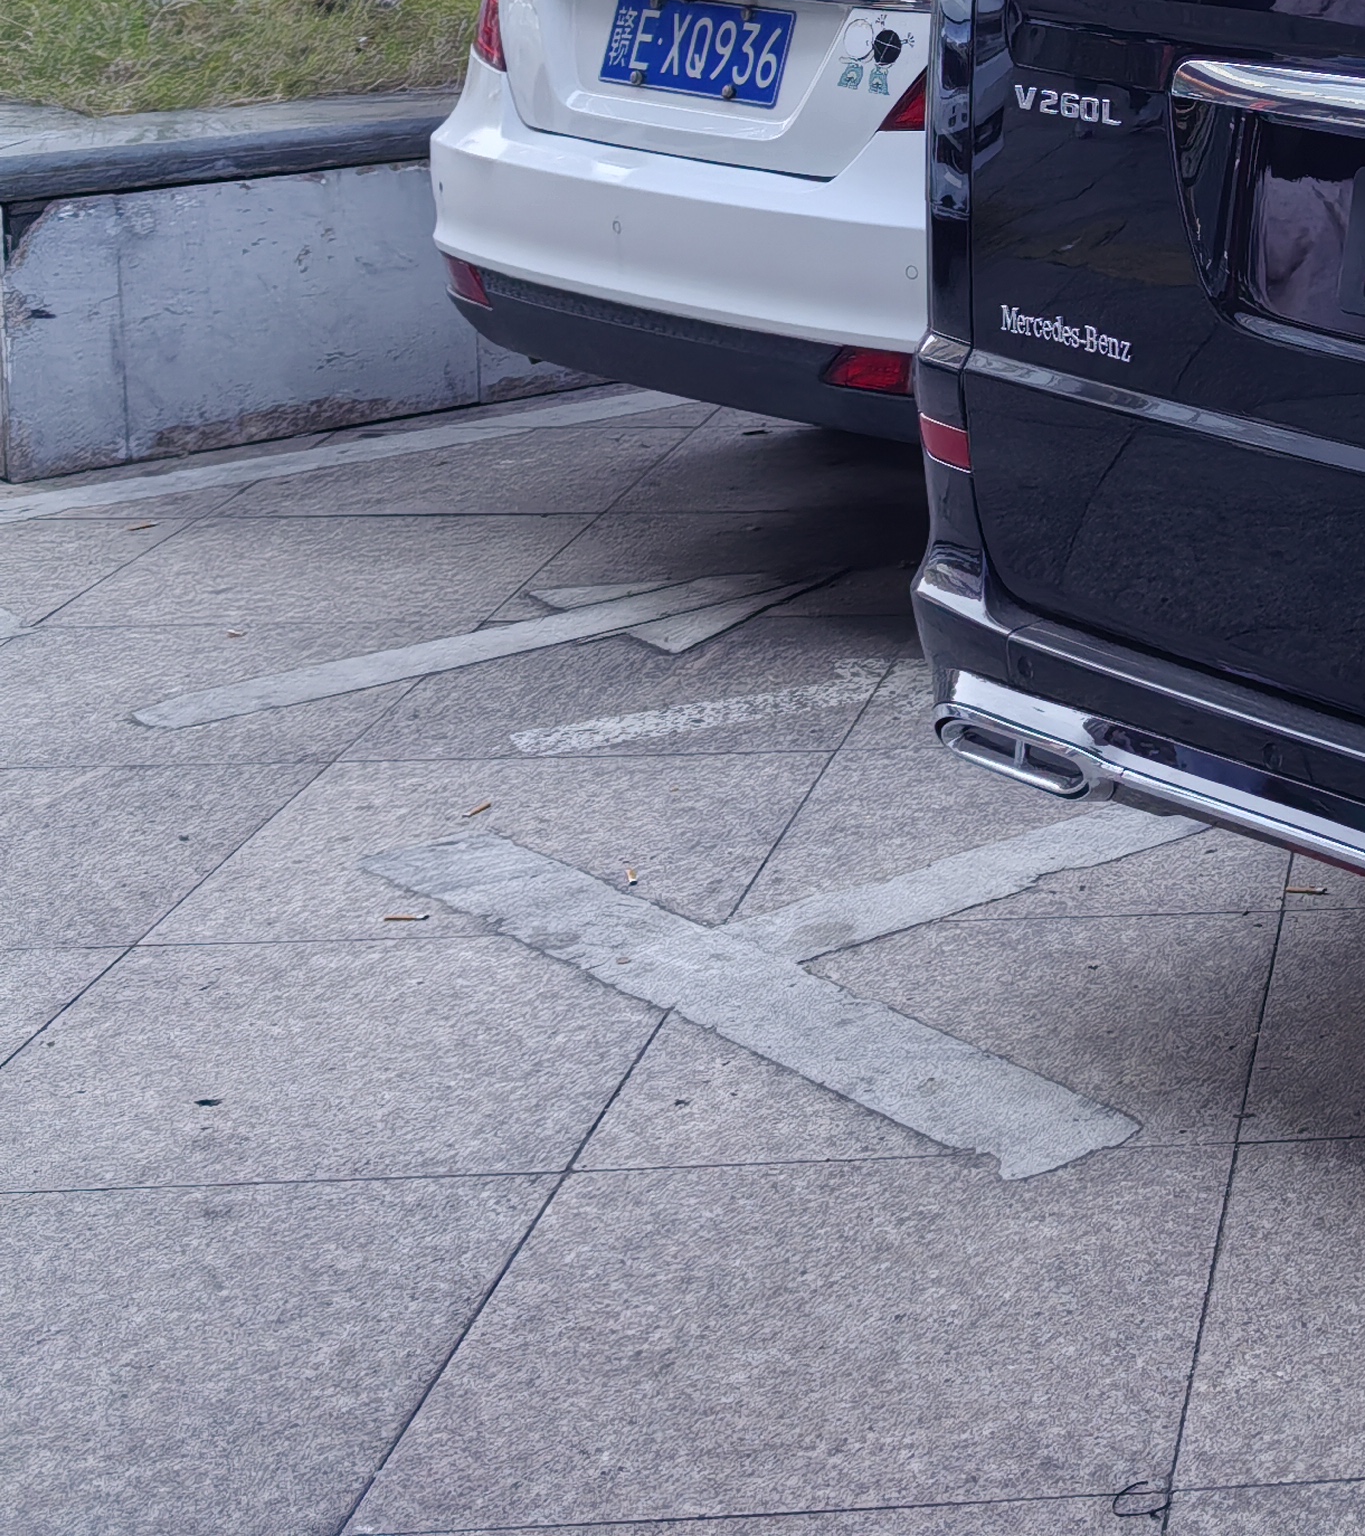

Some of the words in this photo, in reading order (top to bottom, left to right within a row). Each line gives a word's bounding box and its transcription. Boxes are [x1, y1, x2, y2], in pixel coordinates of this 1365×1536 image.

[607, 5, 783, 89] 赣E·XQ936
[1012, 82, 1123, 127] V260L
[998, 304, 1134, 365] Mercedes-Benz
